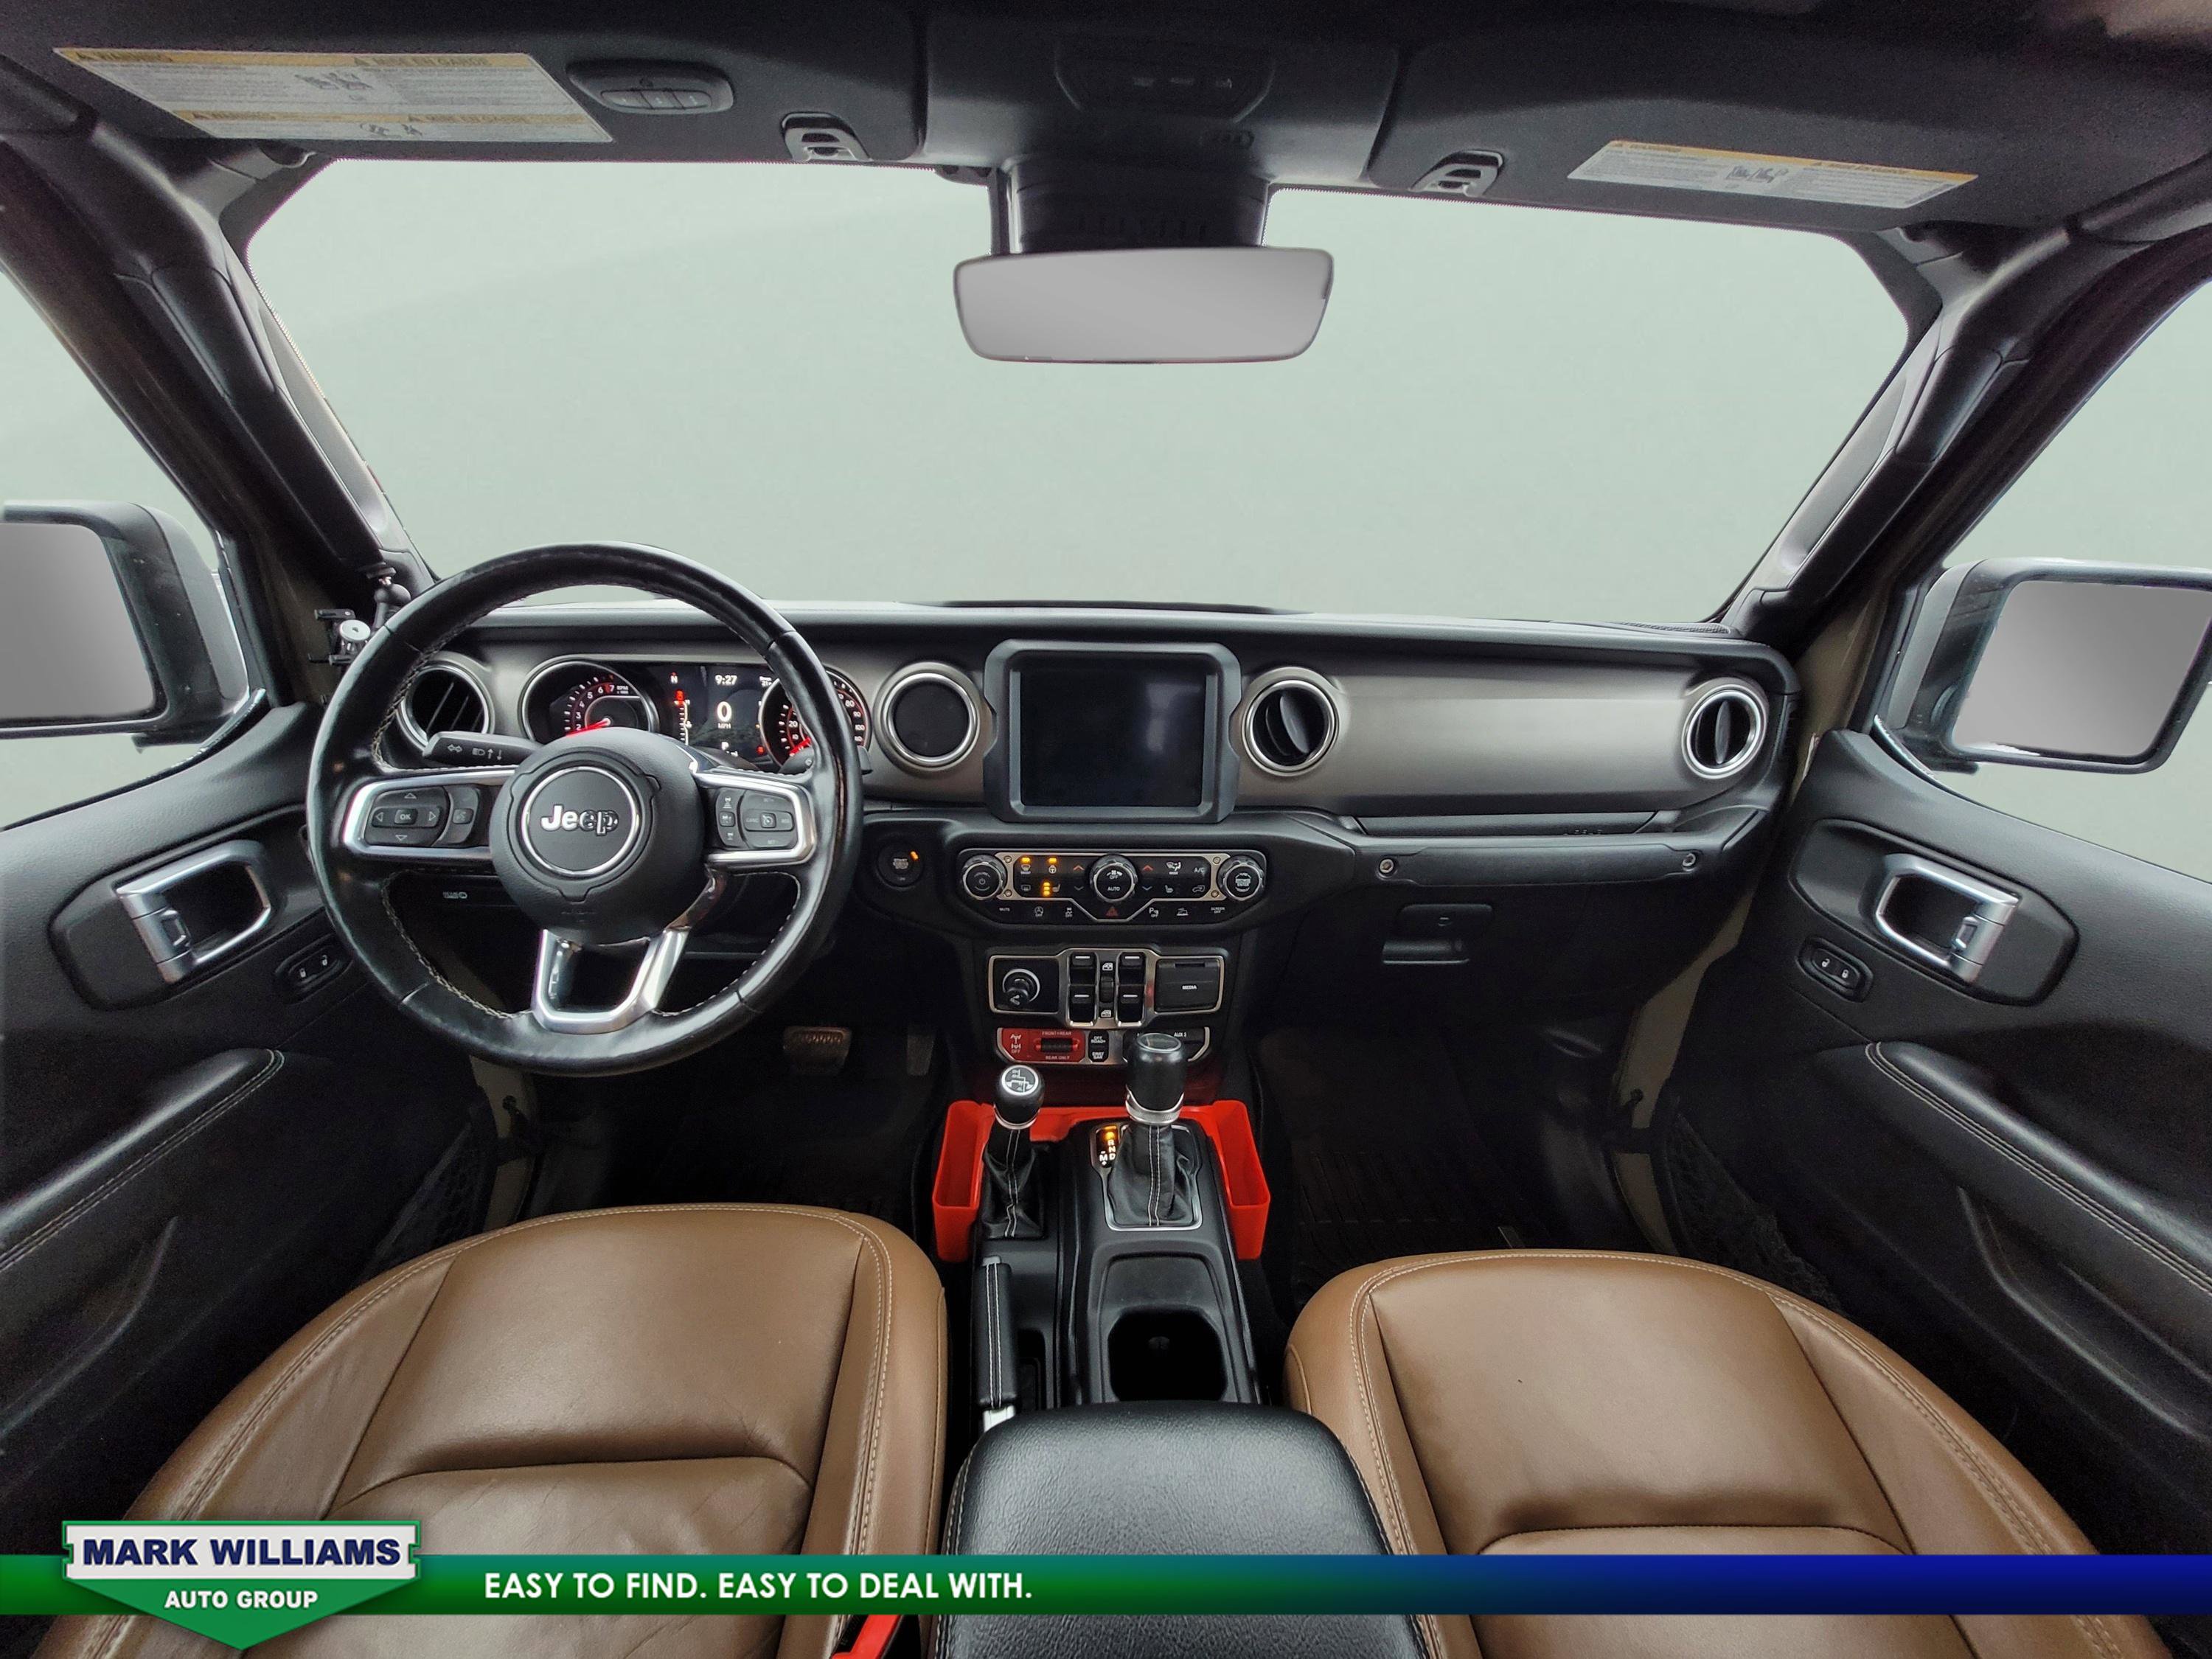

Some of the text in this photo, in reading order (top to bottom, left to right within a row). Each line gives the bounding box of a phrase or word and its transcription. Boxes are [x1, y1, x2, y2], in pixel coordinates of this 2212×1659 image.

[715, 675, 737, 685] 9:27
[609, 684, 615, 692] 7
[579, 700, 585, 709] 4
[717, 701, 732, 722] 0
[540, 804, 619, 836] Jeep
[1108, 1145, 1116, 1153] N
[1099, 1153, 1108, 1162] M
[1109, 1152, 1116, 1161] D
